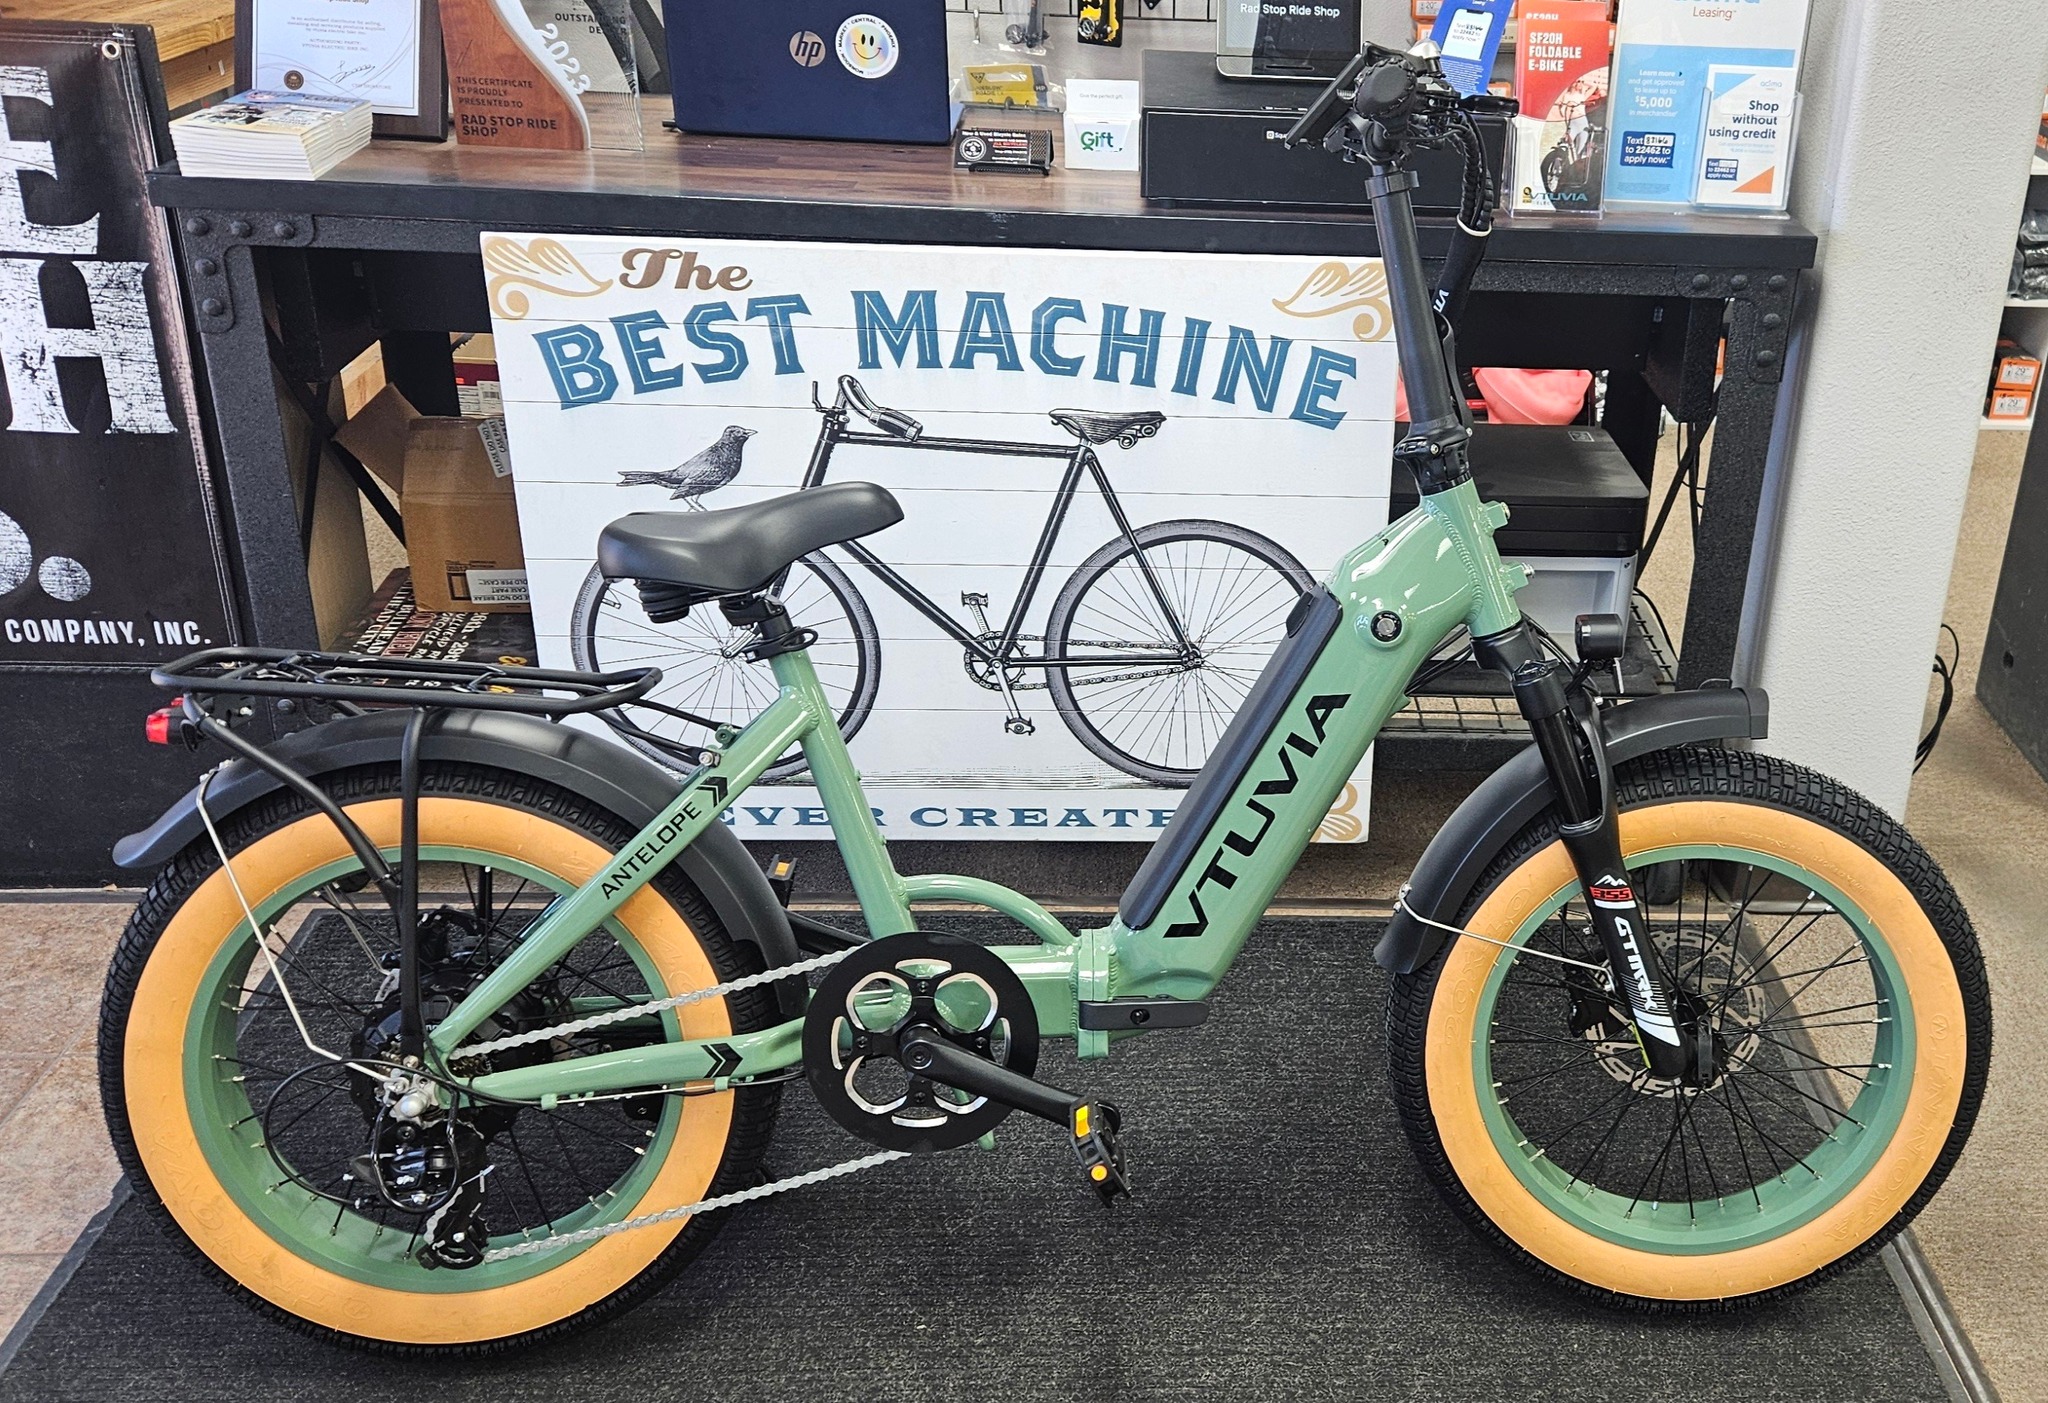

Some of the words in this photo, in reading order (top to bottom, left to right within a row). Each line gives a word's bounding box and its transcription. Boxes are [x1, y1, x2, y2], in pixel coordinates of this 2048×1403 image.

[1240, 4, 1260, 13] Rad
[1263, 4, 1287, 16] Stop
[1289, 5, 1312, 15] Ride
[1314, 6, 1340, 18] Shop
[555, 13, 626, 24] OUTSTANG
[1529, 32, 1563, 44] SF20H
[794, 31, 822, 67] hp
[1528, 46, 1582, 59] FOLDABLE
[542, 23, 591, 95] 2023
[1528, 59, 1564, 72] E-BIKE
[456, 76, 477, 85] THIS
[478, 78, 534, 89] CERTIFICATE
[467, 88, 508, 97] PROUDLY
[459, 97, 511, 108] PRESENTED
[511, 101, 524, 109] TO
[1635, 96, 1673, 108] $5,000
[1749, 100, 1779, 113] Shop
[461, 114, 488, 126] RAD
[491, 116, 525, 129] STOP
[527, 118, 558, 130] RIDE
[1732, 113, 1777, 125] without
[462, 125, 499, 138] SHOP
[1709, 126, 1740, 140] using
[1742, 128, 1776, 139] credit
[1080, 131, 1114, 150] Gift
[1627, 136, 1644, 145] Text
[1625, 146, 1635, 154] to
[1635, 146, 1661, 155] 22462
[1661, 147, 1671, 155] to
[1624, 155, 1647, 164] apply
[1529, 192, 1588, 202] VTUVIA
[618, 248, 753, 293] The
[532, 290, 813, 409] BEST
[850, 289, 1358, 430] MACHINE
[5, 618, 146, 648] COMPANY,
[154, 619, 213, 647] INC.
[909, 807, 1177, 828] CREATE
[1162, 693, 1352, 939] VTUVIA
[601, 801, 702, 900] ANTELOPE
